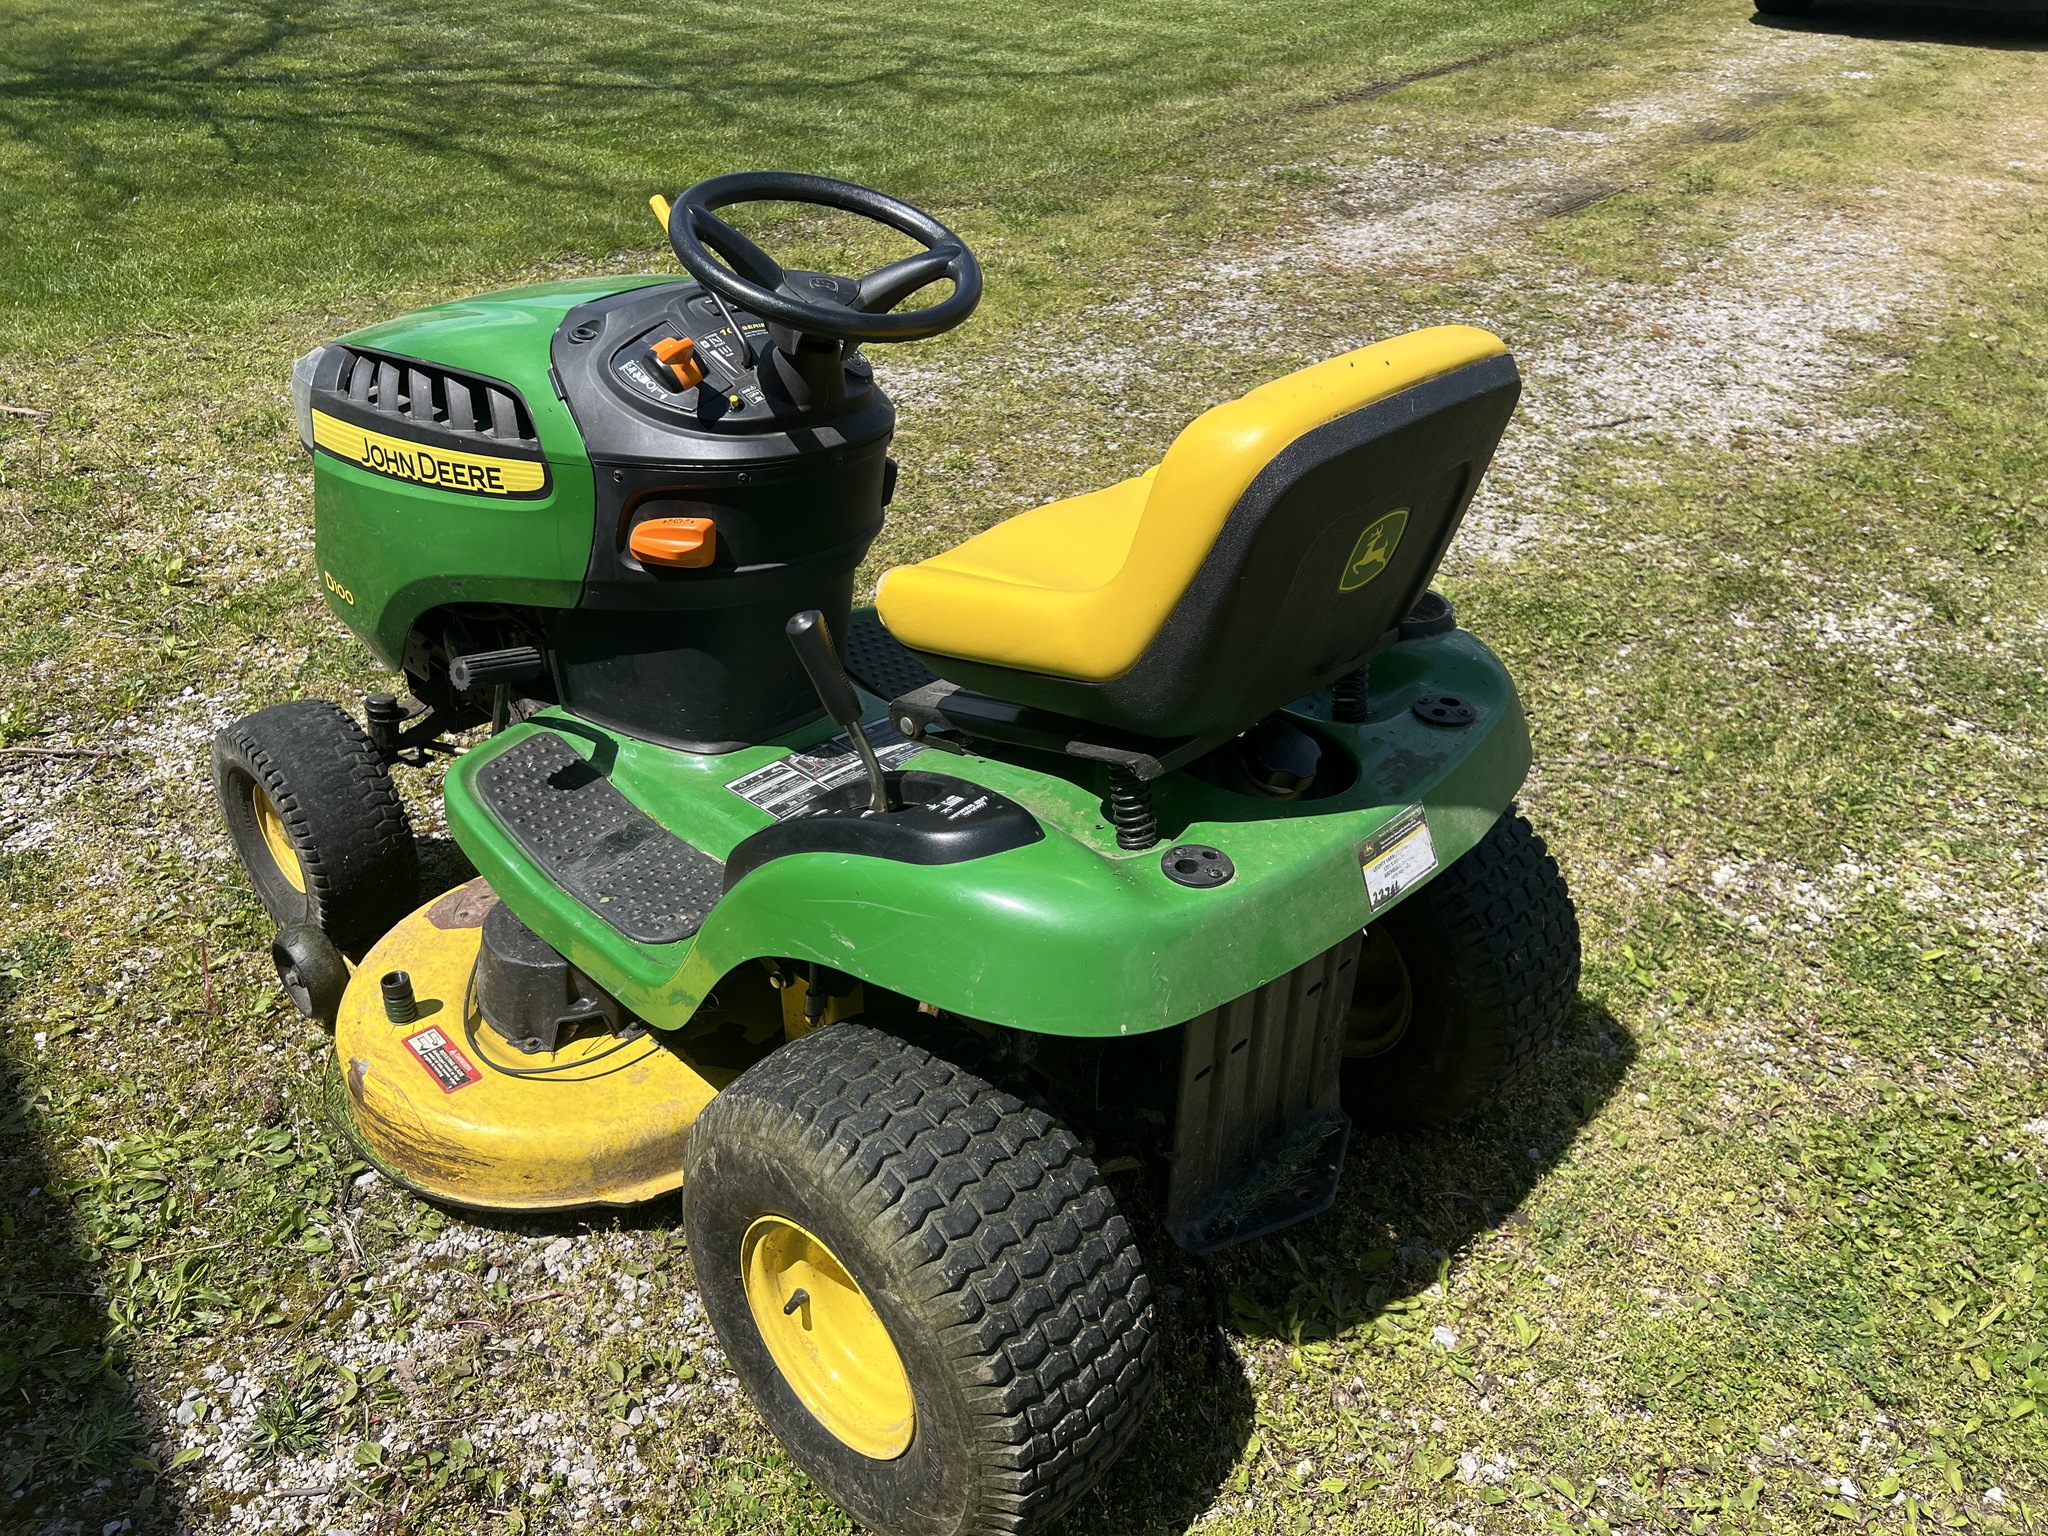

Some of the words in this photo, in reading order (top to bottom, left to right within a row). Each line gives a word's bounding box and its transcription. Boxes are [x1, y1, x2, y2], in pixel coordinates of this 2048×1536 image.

[361, 437, 416, 476] JOHN
[417, 451, 505, 490] DEERE
[324, 570, 354, 606] D100
[454, 1052, 473, 1072] DANGER
